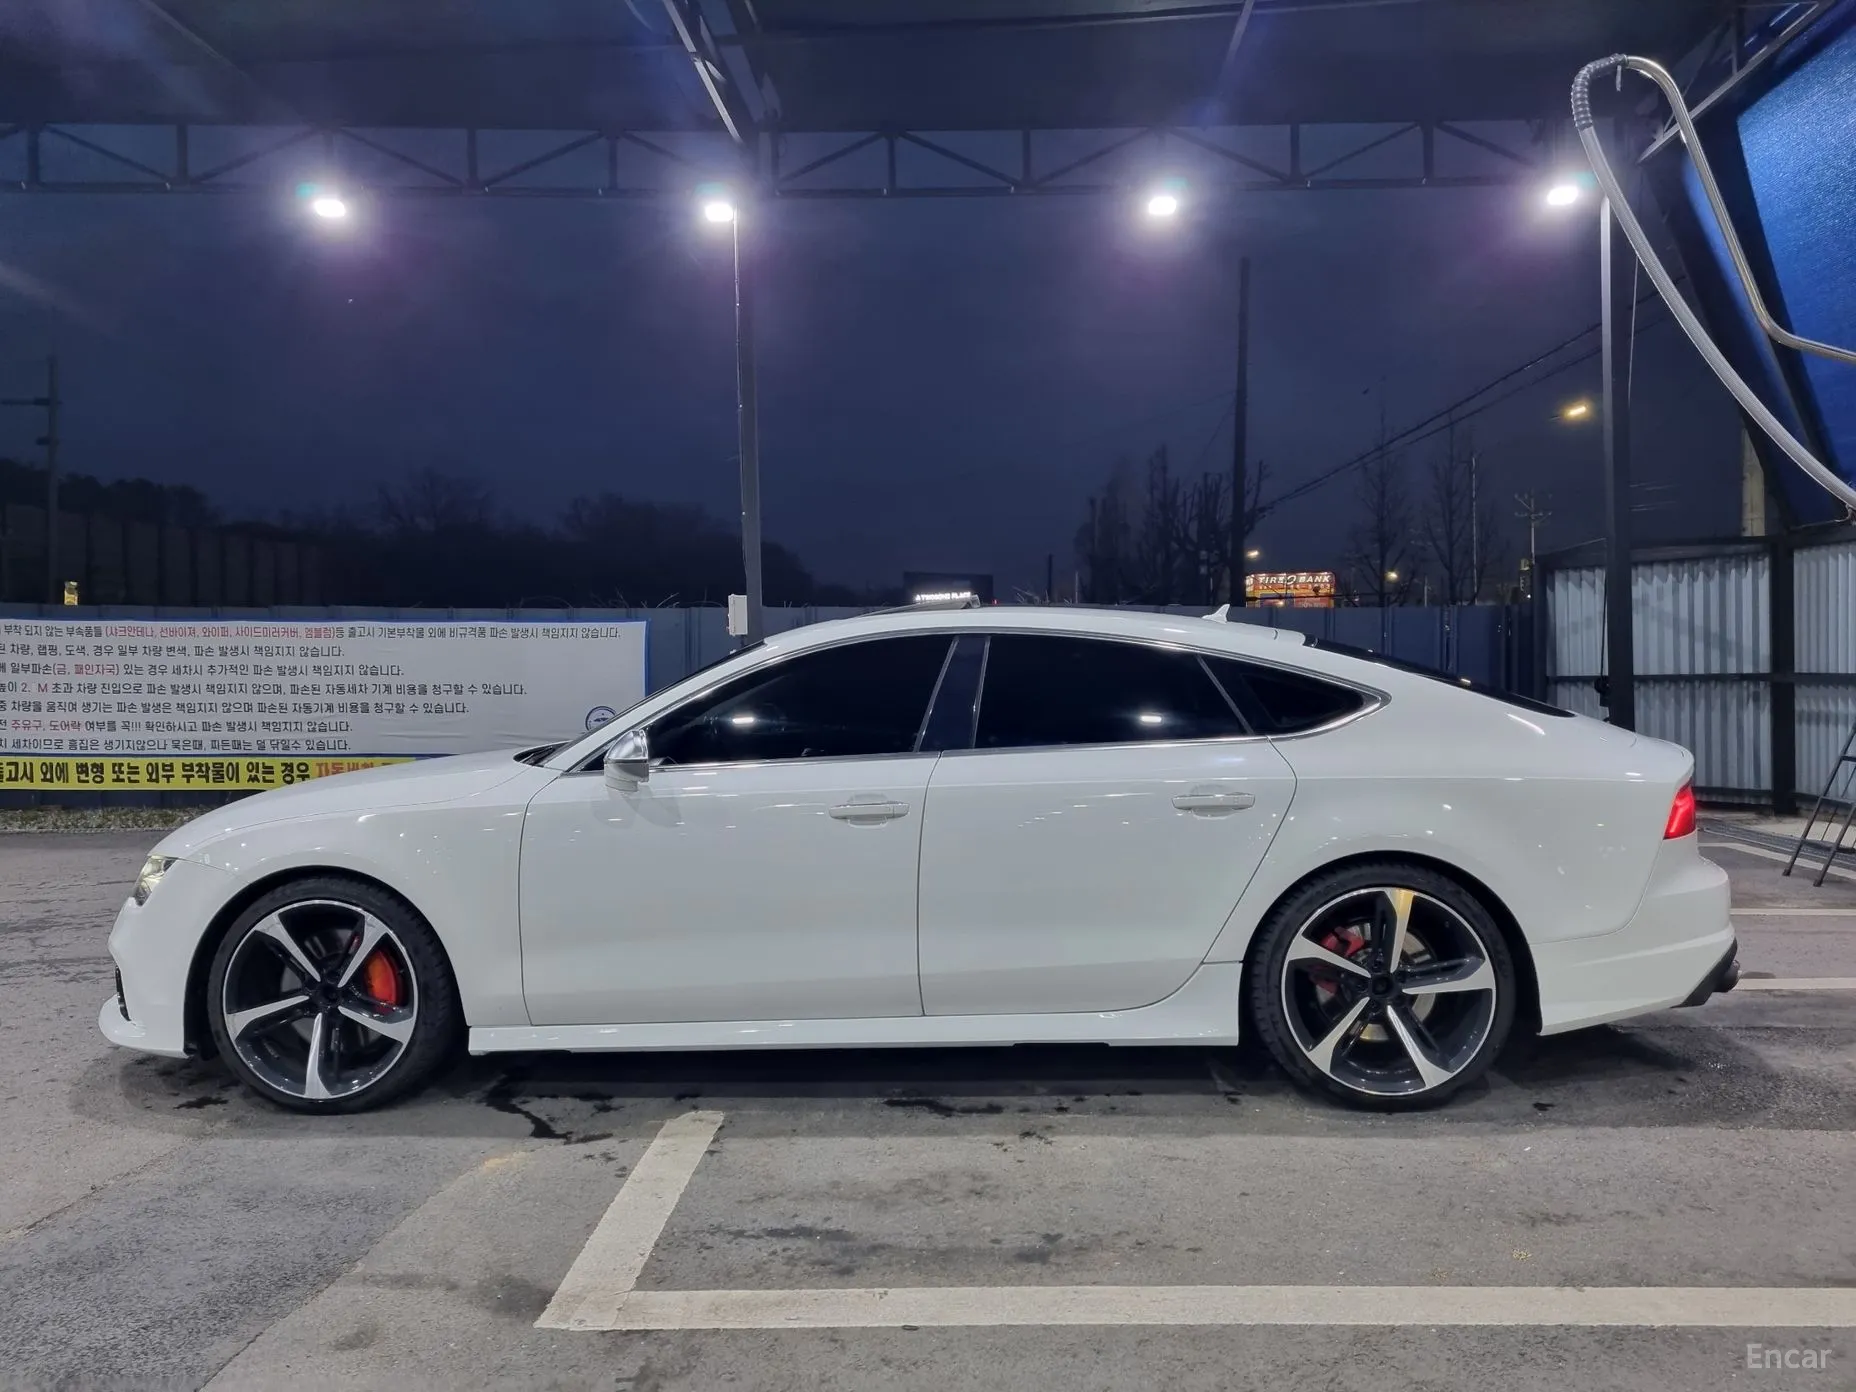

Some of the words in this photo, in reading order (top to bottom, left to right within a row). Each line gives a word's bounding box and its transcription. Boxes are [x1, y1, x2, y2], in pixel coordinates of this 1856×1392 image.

[1299, 575, 1330, 583] BANK
[4, 624, 22, 635] 부착
[25, 625, 42, 636] 되지
[45, 626, 63, 637] 않는
[66, 626, 102, 637] 부속품들
[202, 625, 232, 637] 와이퍼,
[235, 625, 301, 638] 사이드미러커버,
[348, 626, 374, 638] 출고시
[379, 626, 424, 638] 기본부착물
[428, 626, 446, 638] 외에
[450, 626, 486, 638] 비규격품
[490, 626, 507, 638] 파손
[511, 626, 538, 638] 발생시
[542, 626, 578, 638] 책임지지
[581, 626, 620, 638] 않습니다.
[10, 643, 33, 655] 차량,
[38, 644, 61, 656] 랩핑,
[65, 645, 89, 656] 도색,
[93, 645, 114, 656] 경우
[118, 645, 138, 656] 일부
[142, 645, 163, 657] 차량
[166, 646, 190, 657] 변색,
[194, 646, 214, 657] 파손
[219, 645, 249, 657] 발생시
[254, 646, 294, 657] 책임지지
[300, 646, 344, 657] 않습니다.
[124, 664, 144, 675] 있는
[148, 665, 167, 675] 경우
[172, 665, 202, 676] 세차시
[208, 664, 248, 675] 추가적인
[253, 665, 272, 676] 파손
[276, 665, 307, 676] 발생시
[313, 665, 354, 676] 책임지지
[359, 665, 404, 676] 않습니다.
[38, 683, 48, 692] M
[52, 683, 73, 693] 초과
[77, 683, 97, 694] 차량
[101, 683, 142, 694] 진입으로
[147, 684, 166, 695] 파손
[170, 684, 201, 695] 발생시
[206, 683, 247, 695] 책임지지
[252, 684, 285, 695] 않으며,
[290, 684, 320, 695] 파손된
[326, 684, 368, 695] 자동세차
[372, 684, 392, 695] 기계
[396, 684, 427, 695] 비용을
[432, 684, 464, 695] 청구할
[468, 684, 478, 695] 수
[482, 684, 527, 695] 있습니다.
[11, 701, 42, 712] 차량을
[47, 702, 77, 712] 움직여
[82, 702, 112, 713] 생기는
[117, 702, 137, 713] 파손
[141, 702, 172, 713] 발생은
[176, 703, 217, 713] 책임지지
[222, 702, 253, 713] 않으며
[257, 703, 288, 713] 파손된
[292, 703, 334, 714] 자동기계
[336, 702, 370, 713] 비용을
[374, 703, 405, 714] 청구할
[409, 703, 419, 713] 수
[423, 703, 469, 714] 있습니다.
[11, 720, 45, 731] 주유구,
[49, 721, 81, 731] 도어락
[85, 721, 116, 732] 여부를
[121, 721, 140, 732] 꼭!!!
[145, 721, 198, 732] 확인하시고
[202, 721, 222, 732] 파손
[226, 721, 257, 732] 발생시
[261, 721, 302, 732] 책임지지
[307, 721, 352, 733] 않습니다.
[11, 739, 63, 751] 세차이므로
[104, 740, 168, 751] 생기지않으나
[305, 740, 351, 751] 있습니다.
[40, 762, 70, 783] 외에
[74, 762, 104, 784] 변형
[112, 762, 142, 783] 또는
[144, 762, 177, 785] 외부
[180, 762, 240, 785] 부착물이
[244, 761, 277, 786] 있는
[281, 762, 310, 785] 경우
